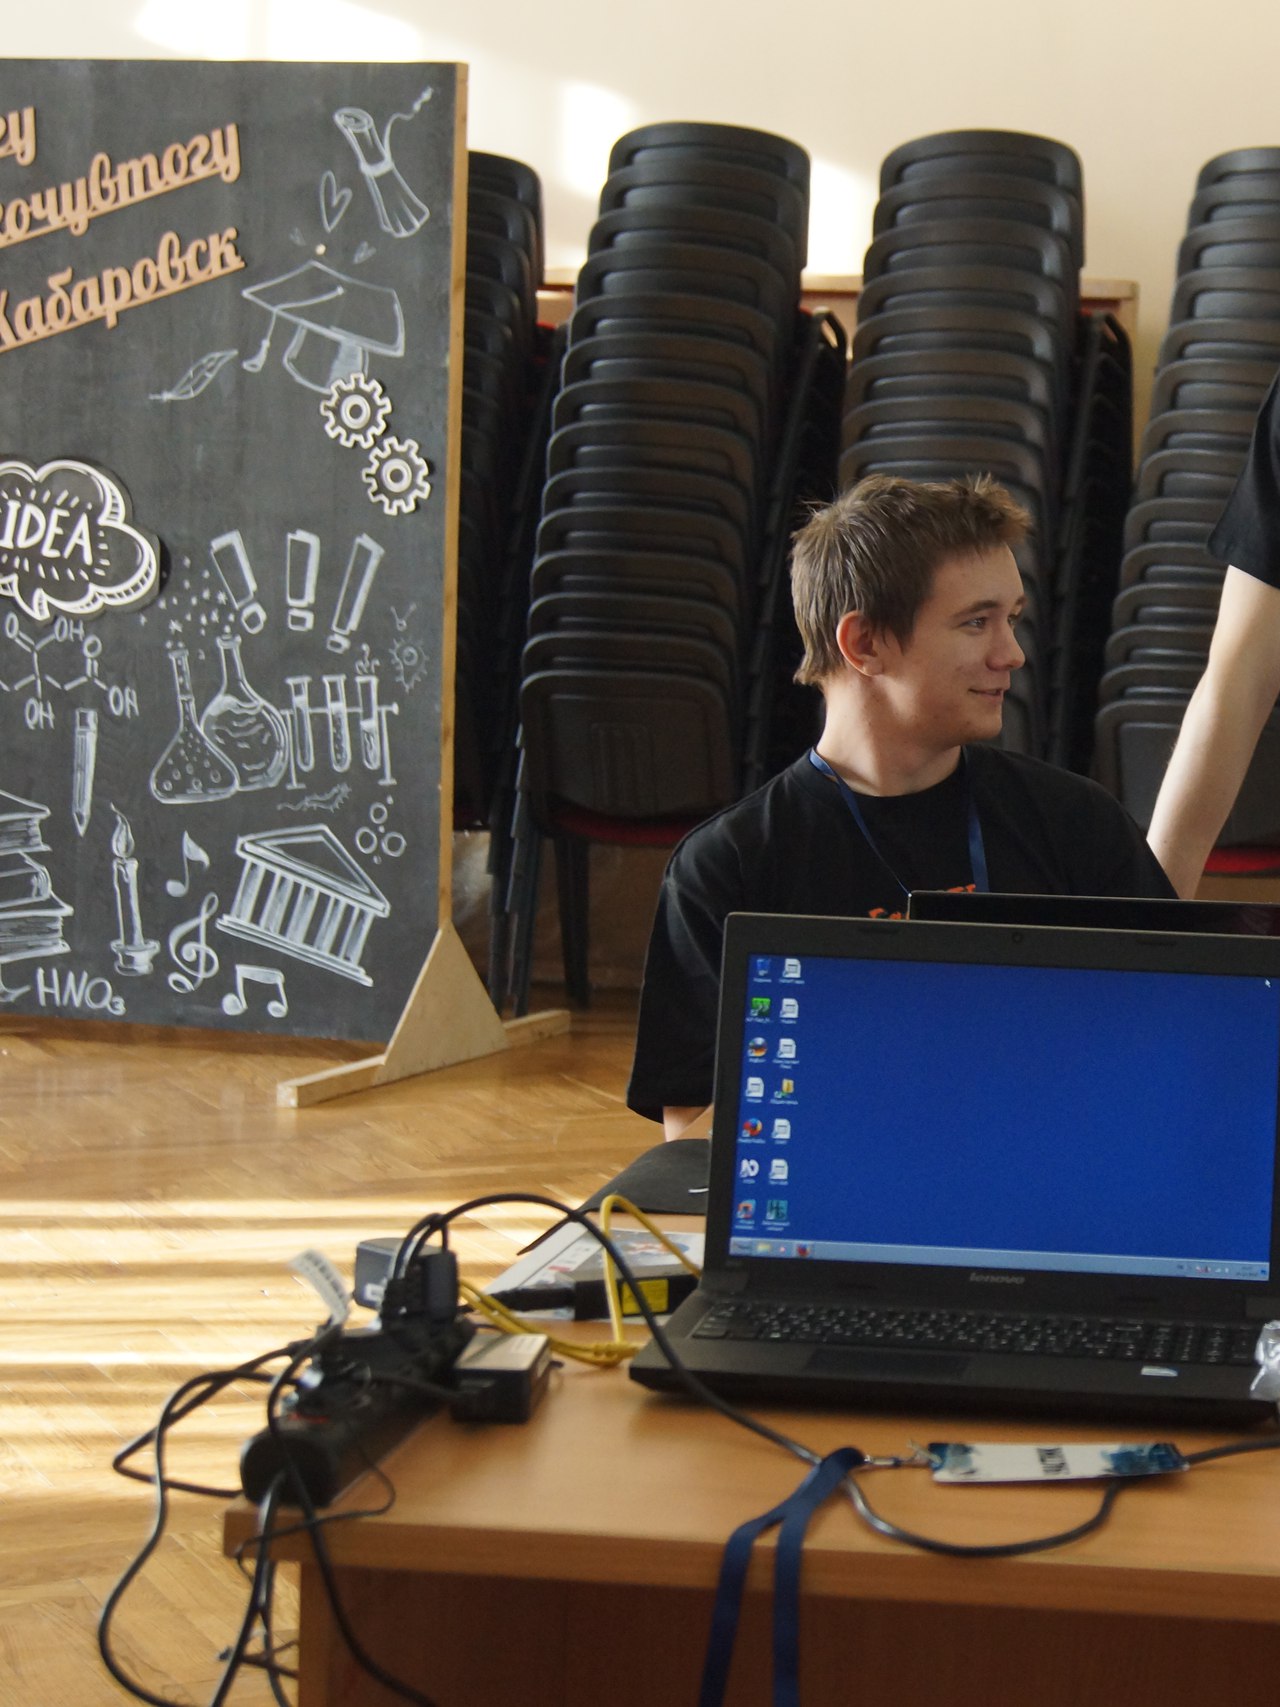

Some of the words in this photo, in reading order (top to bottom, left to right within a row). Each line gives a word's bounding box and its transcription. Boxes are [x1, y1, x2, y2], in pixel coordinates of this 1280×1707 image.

[0, 122, 241, 248] очувтогу
[0, 499, 93, 566] IDEA
[54, 615, 85, 642] OH
[24, 697, 55, 730] OH
[108, 685, 139, 719] OH
